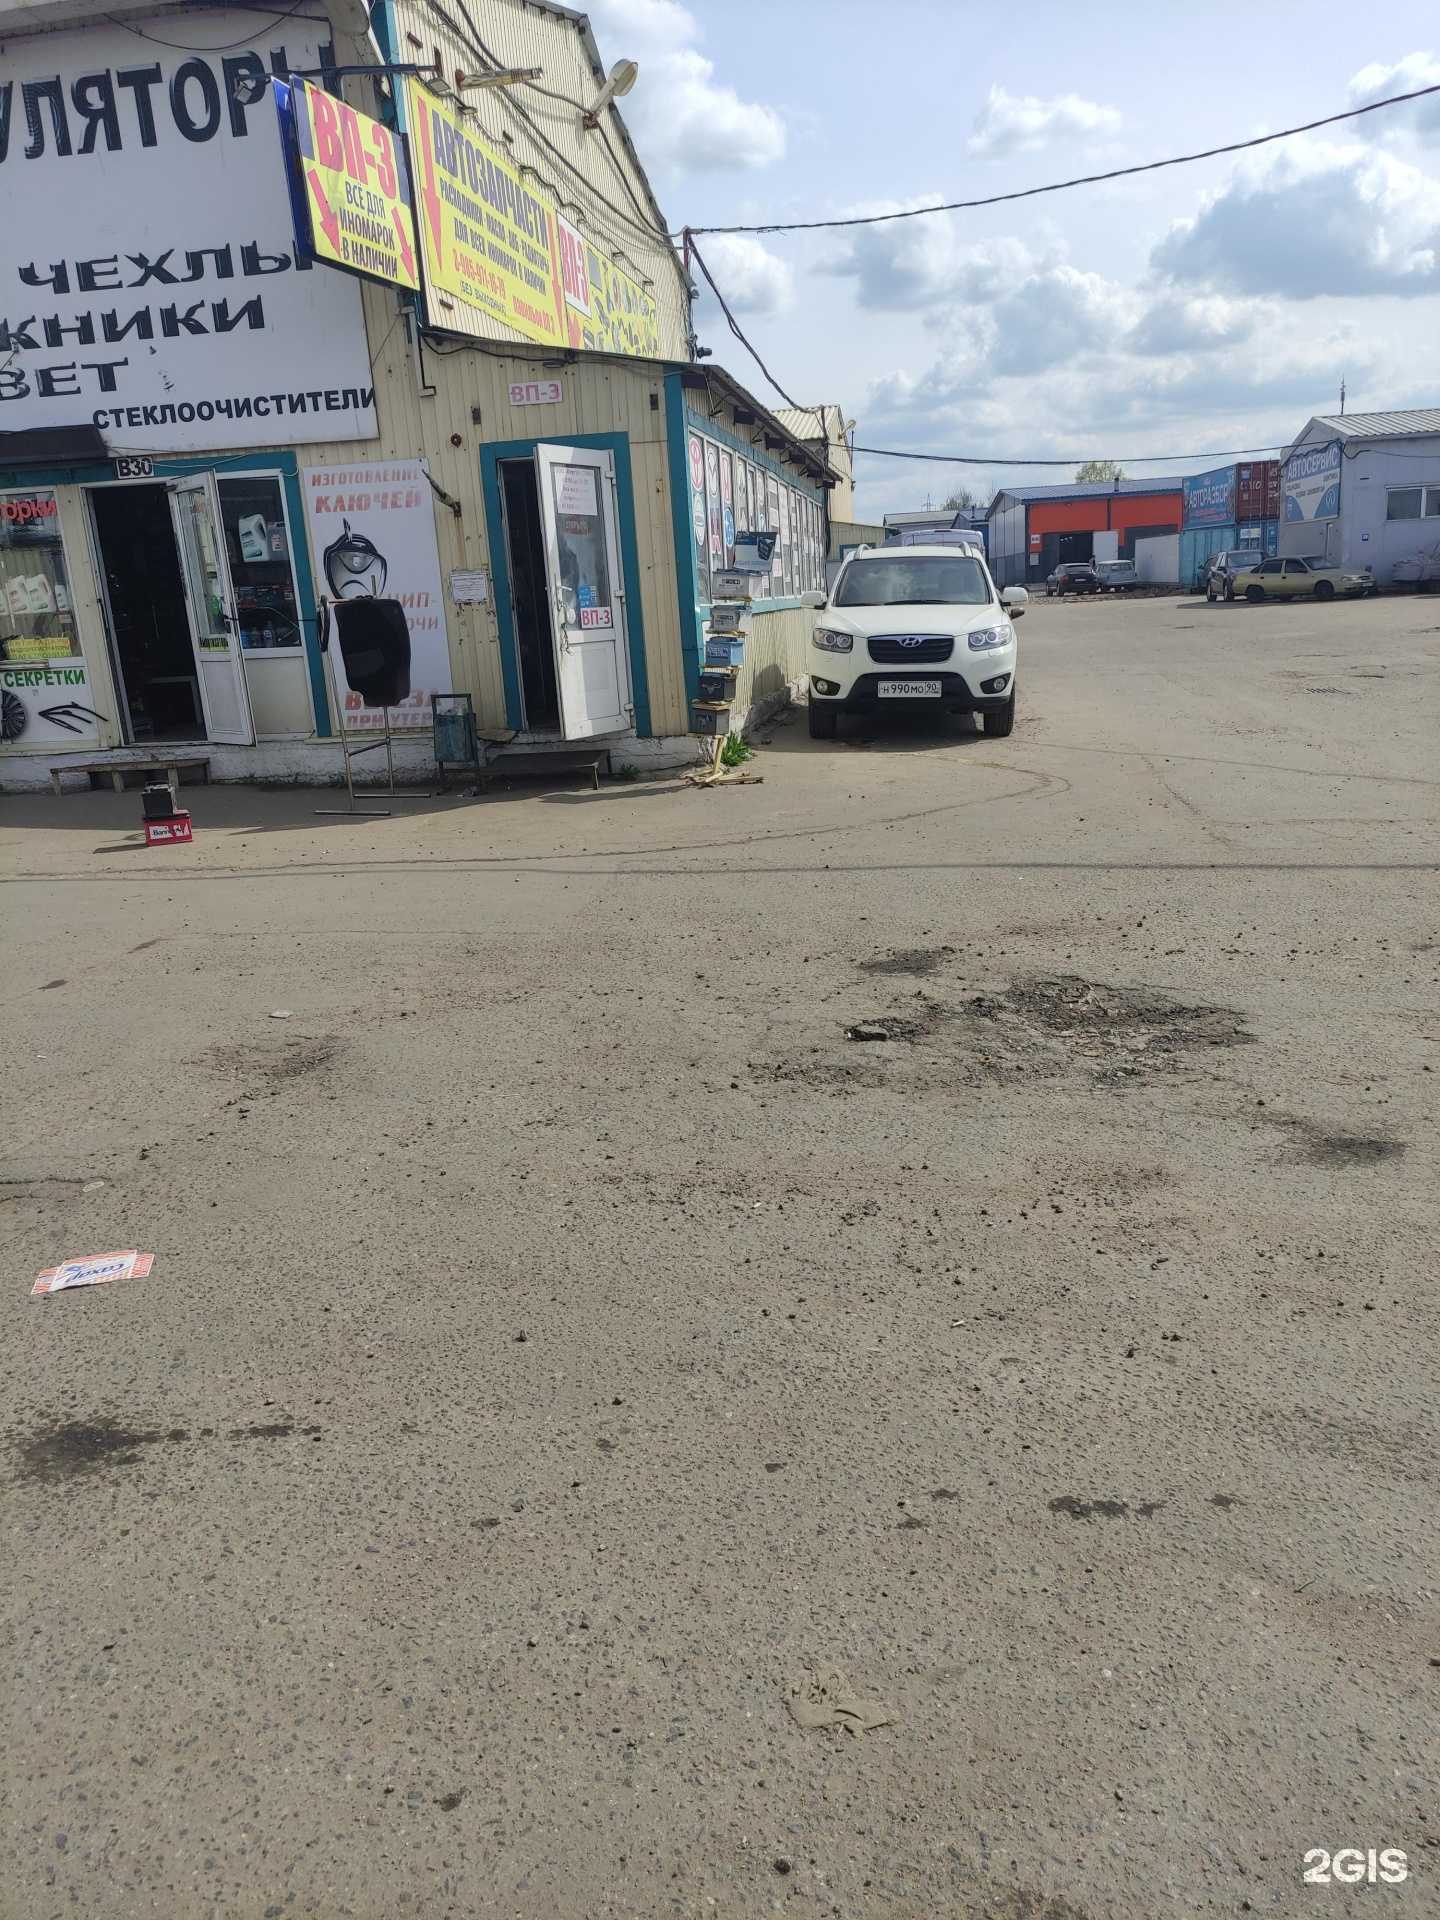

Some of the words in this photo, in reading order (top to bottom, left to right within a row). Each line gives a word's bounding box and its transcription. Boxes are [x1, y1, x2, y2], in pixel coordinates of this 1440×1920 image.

[309, 87, 396, 200] ВП-3
[431, 107, 549, 252] АВТОЗАПЧАСТИ
[367, 190, 385, 220] ДЛЯ
[340, 207, 395, 250] ИНОМАРОК
[18, 241, 313, 295] ЧЕХЛЫ
[342, 237, 350, 261] В
[352, 241, 398, 279] НАЛИЧИИ
[560, 224, 589, 308] ВП-3
[93, 388, 375, 429] СТЕКЛООЧИСТИТЕЛИ
[511, 384, 560, 402] ВП-3
[1287, 447, 1338, 480] АВТОСЕРВИС
[315, 486, 421, 513] КЛЮЧЕЙ
[582, 610, 610, 625] ВП-3
[4, 669, 86, 687] СЕКРЕТКИ
